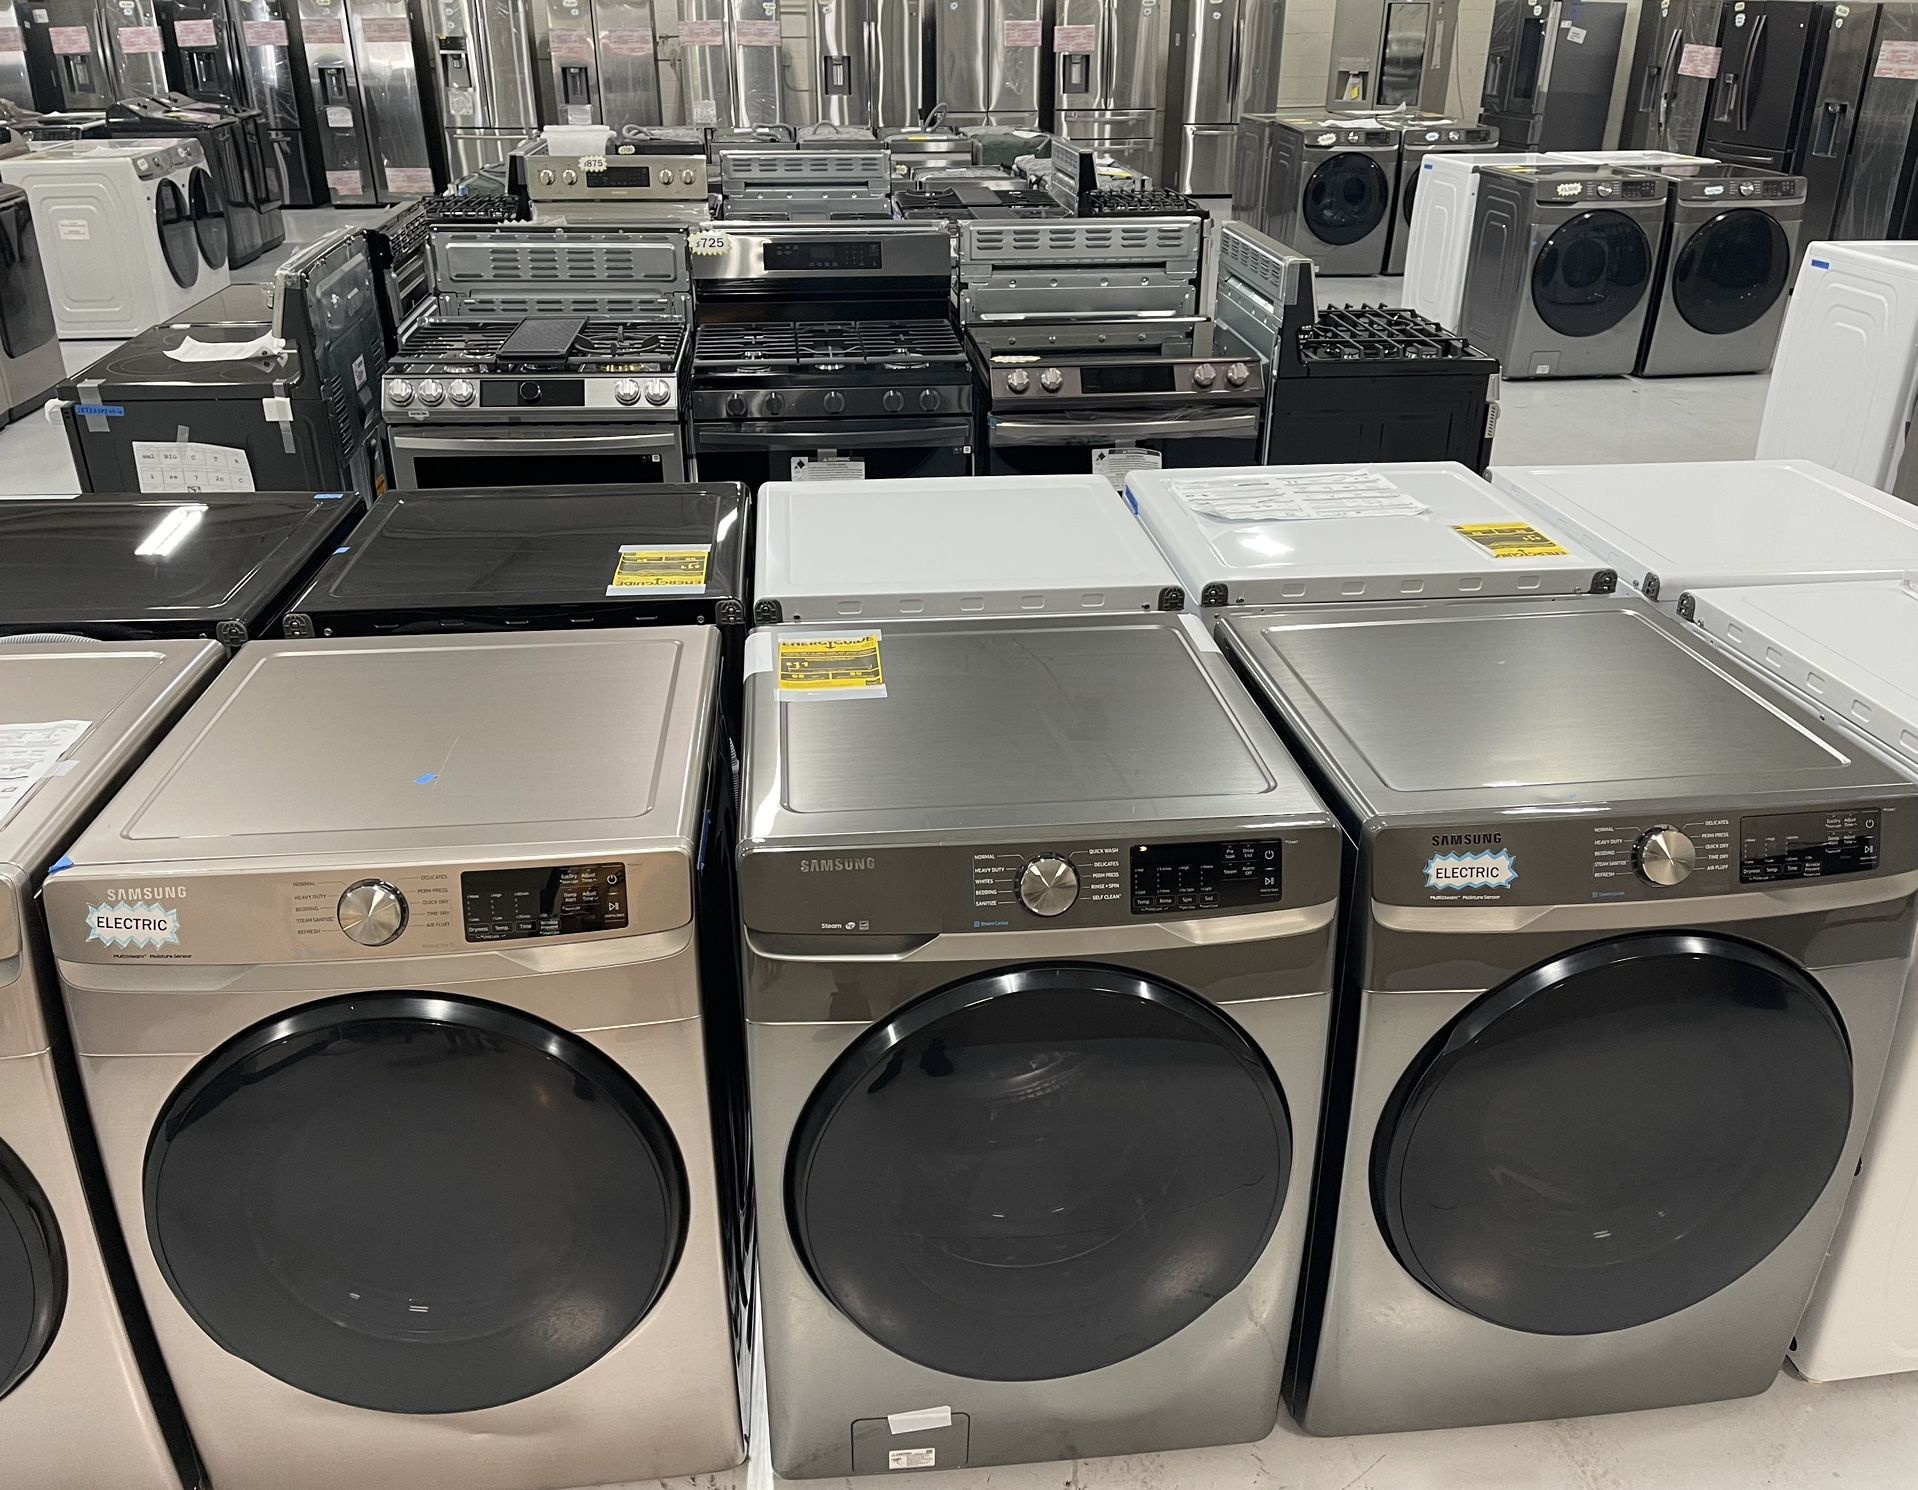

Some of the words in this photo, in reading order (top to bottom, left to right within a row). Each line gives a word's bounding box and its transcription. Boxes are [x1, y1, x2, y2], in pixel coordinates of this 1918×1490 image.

[583, 160, 603, 168] $875
[696, 238, 725, 249] $725
[1431, 832, 1502, 847] SAMSUNG
[800, 857, 876, 872] SAMSUNG
[1435, 866, 1500, 879] ELECTRIC
[106, 886, 188, 902] SAMSUNG
[96, 916, 168, 932] ELECTRIC
[820, 922, 842, 930] Steam
